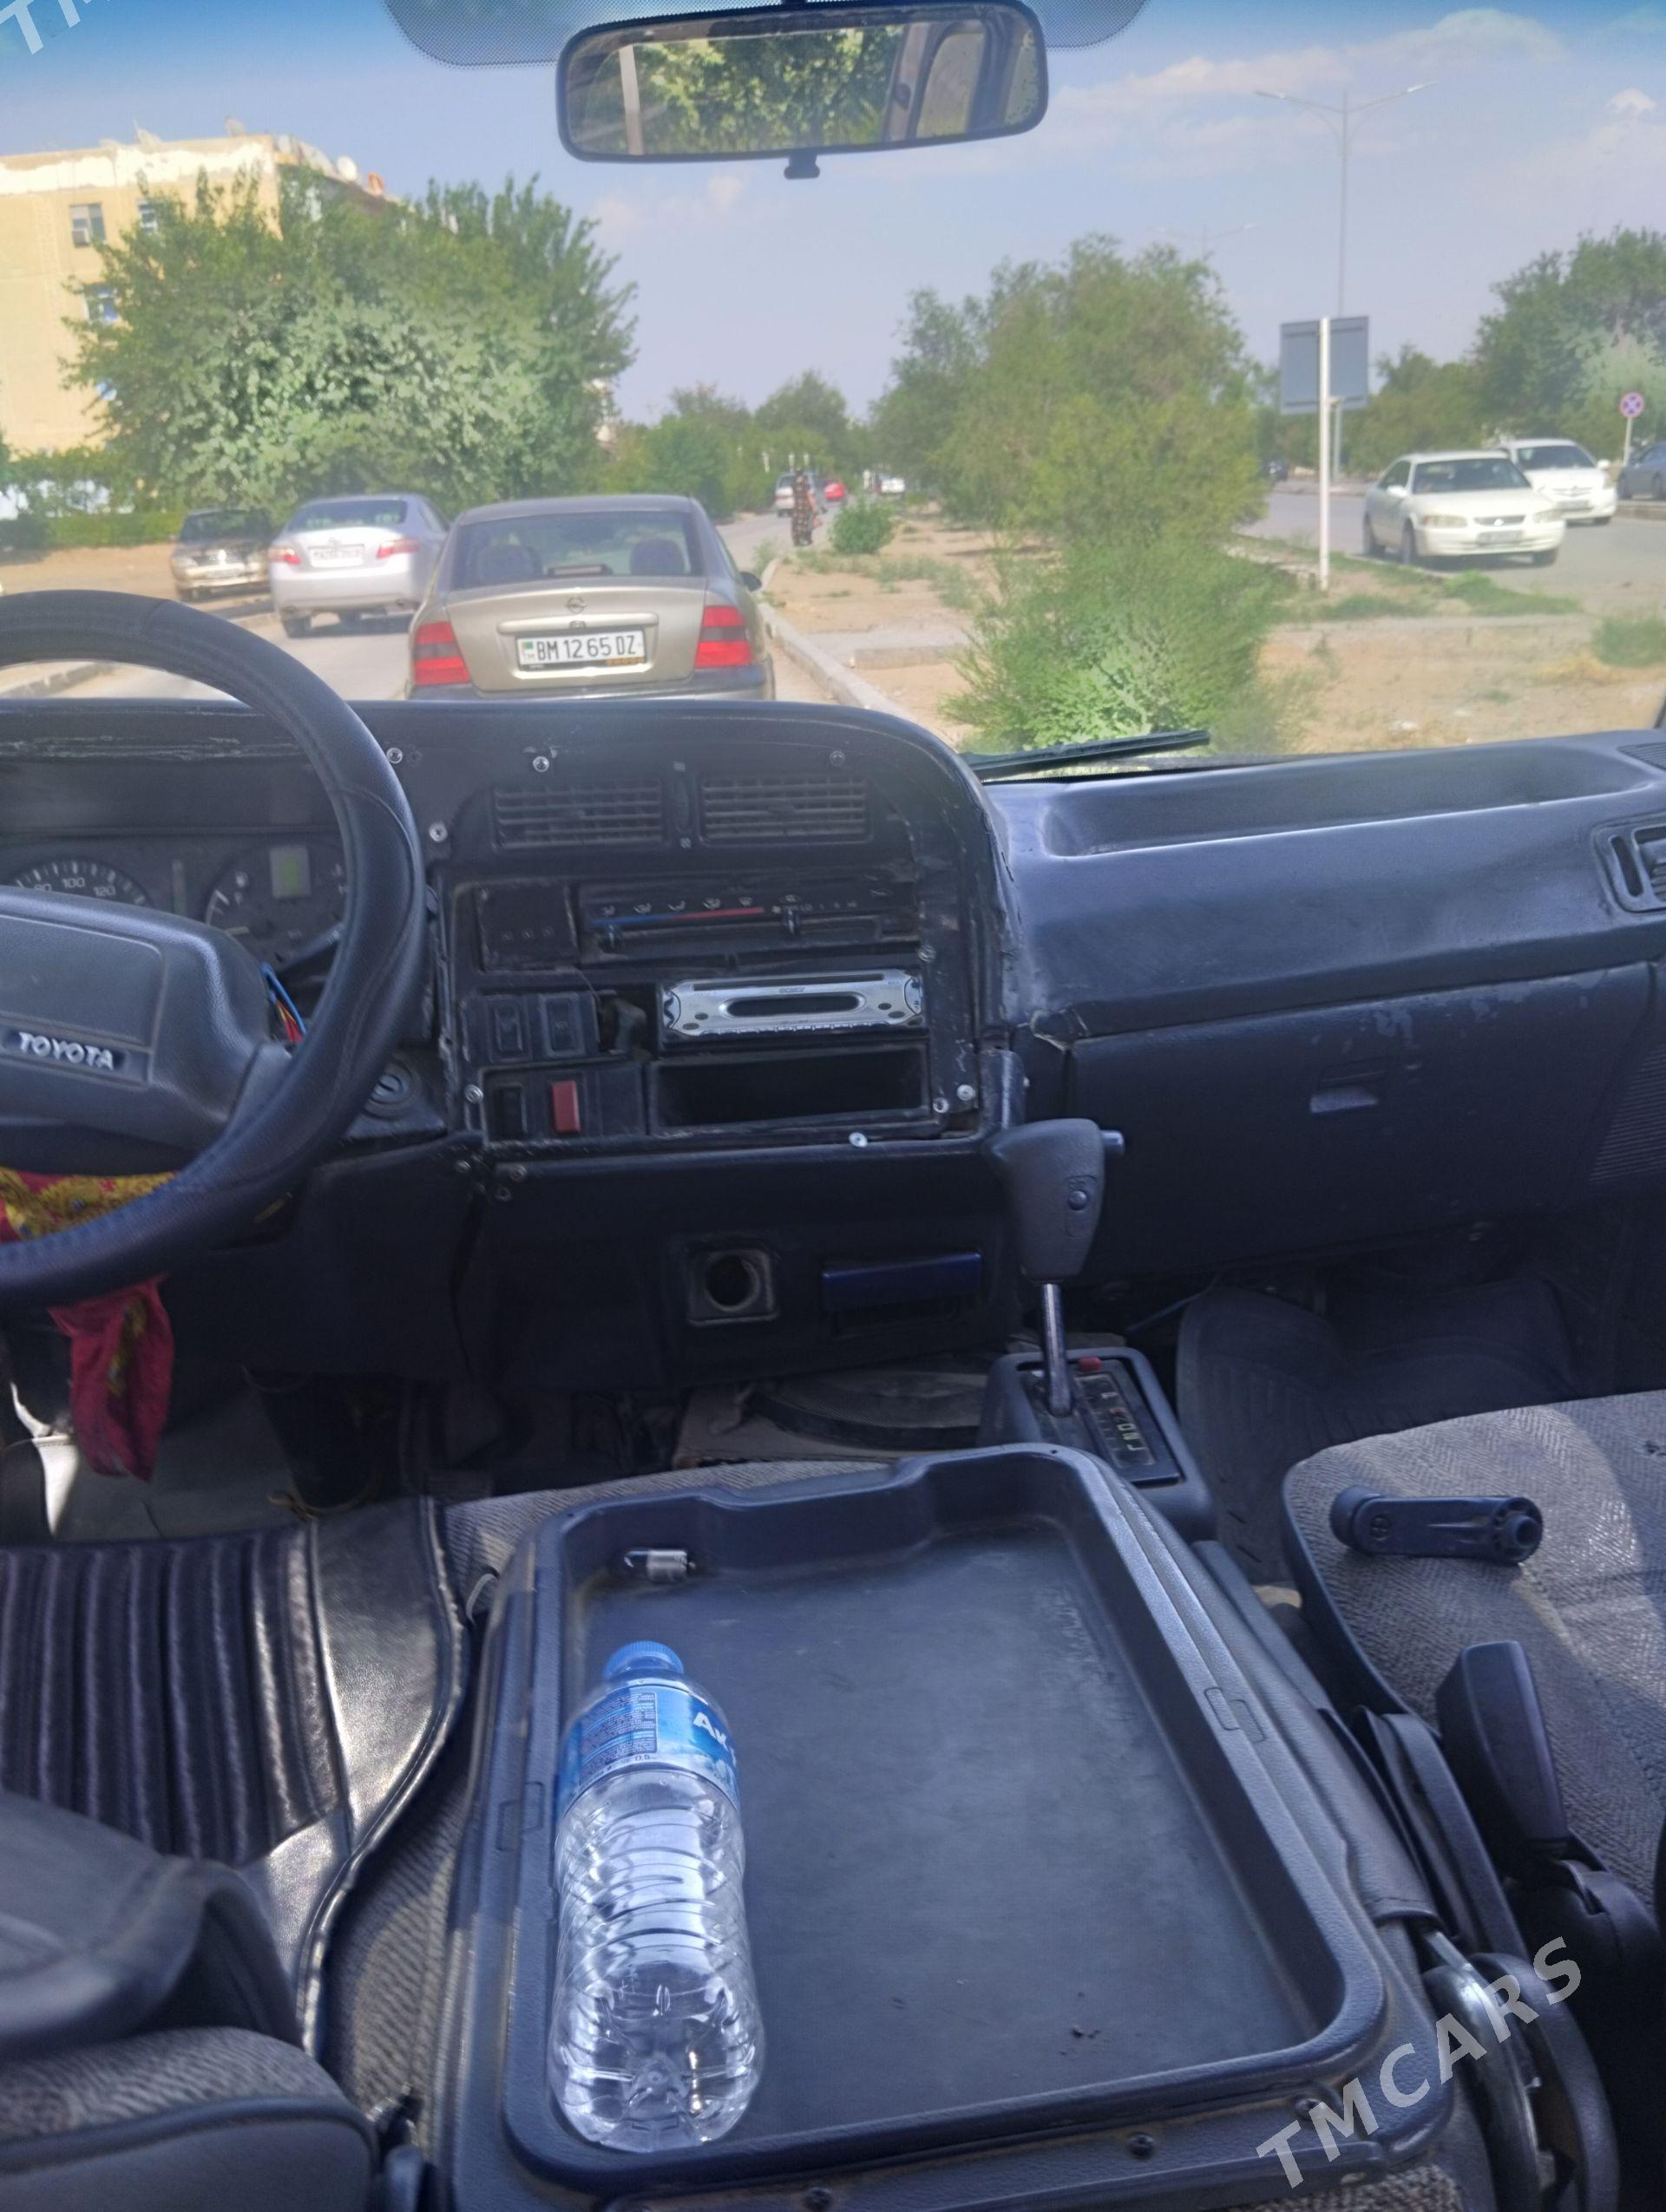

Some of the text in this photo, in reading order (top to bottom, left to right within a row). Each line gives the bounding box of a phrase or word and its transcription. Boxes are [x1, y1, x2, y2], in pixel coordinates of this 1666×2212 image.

[536, 640, 559, 661] BM
[62, 876, 86, 889] 100
[93, 885, 116, 897] 120
[18, 1031, 115, 1071] TOYOTA
